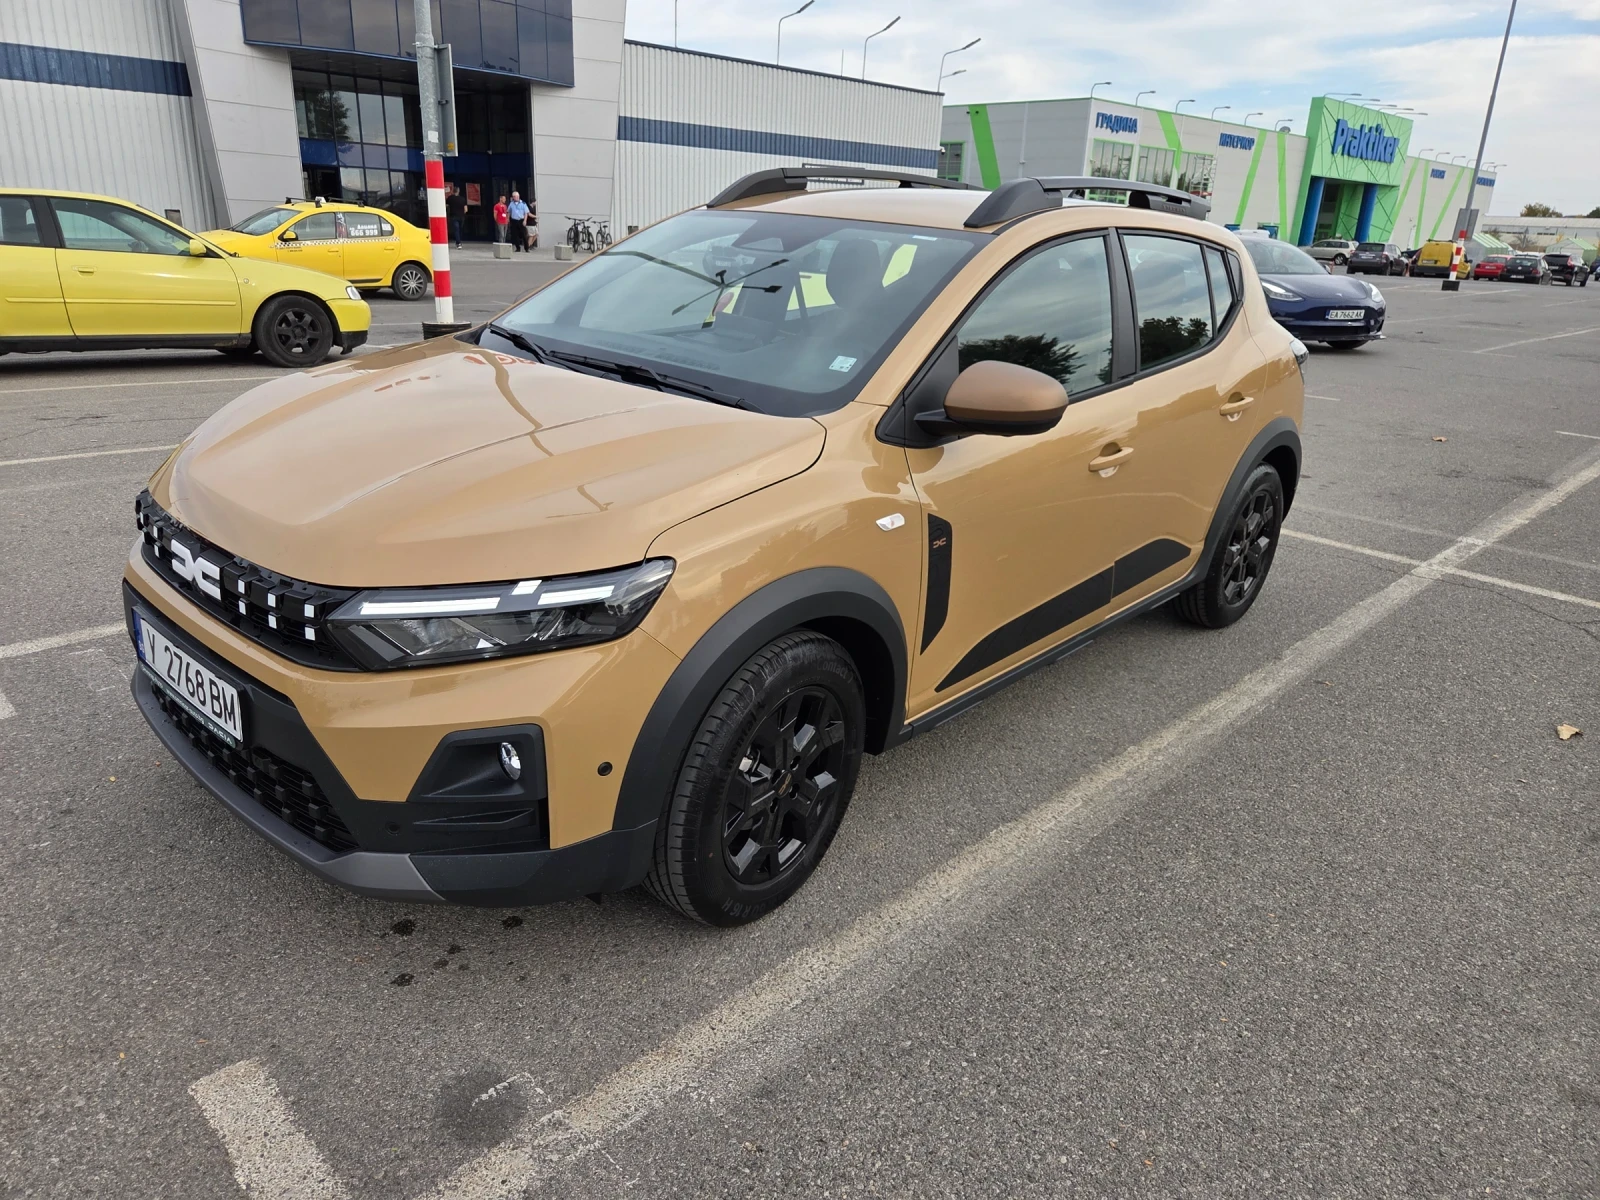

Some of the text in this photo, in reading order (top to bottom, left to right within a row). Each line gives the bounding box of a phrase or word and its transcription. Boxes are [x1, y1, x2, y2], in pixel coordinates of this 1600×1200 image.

[1095, 112, 1138, 134] ГРАДИНА
[1219, 132, 1255, 151] ИНТЕРИОР
[1332, 118, 1400, 164] Praktiker
[1330, 311, 1339, 319] EA
[146, 628, 155, 664] Y
[164, 645, 207, 707] 2768
[208, 677, 238, 731] BM
